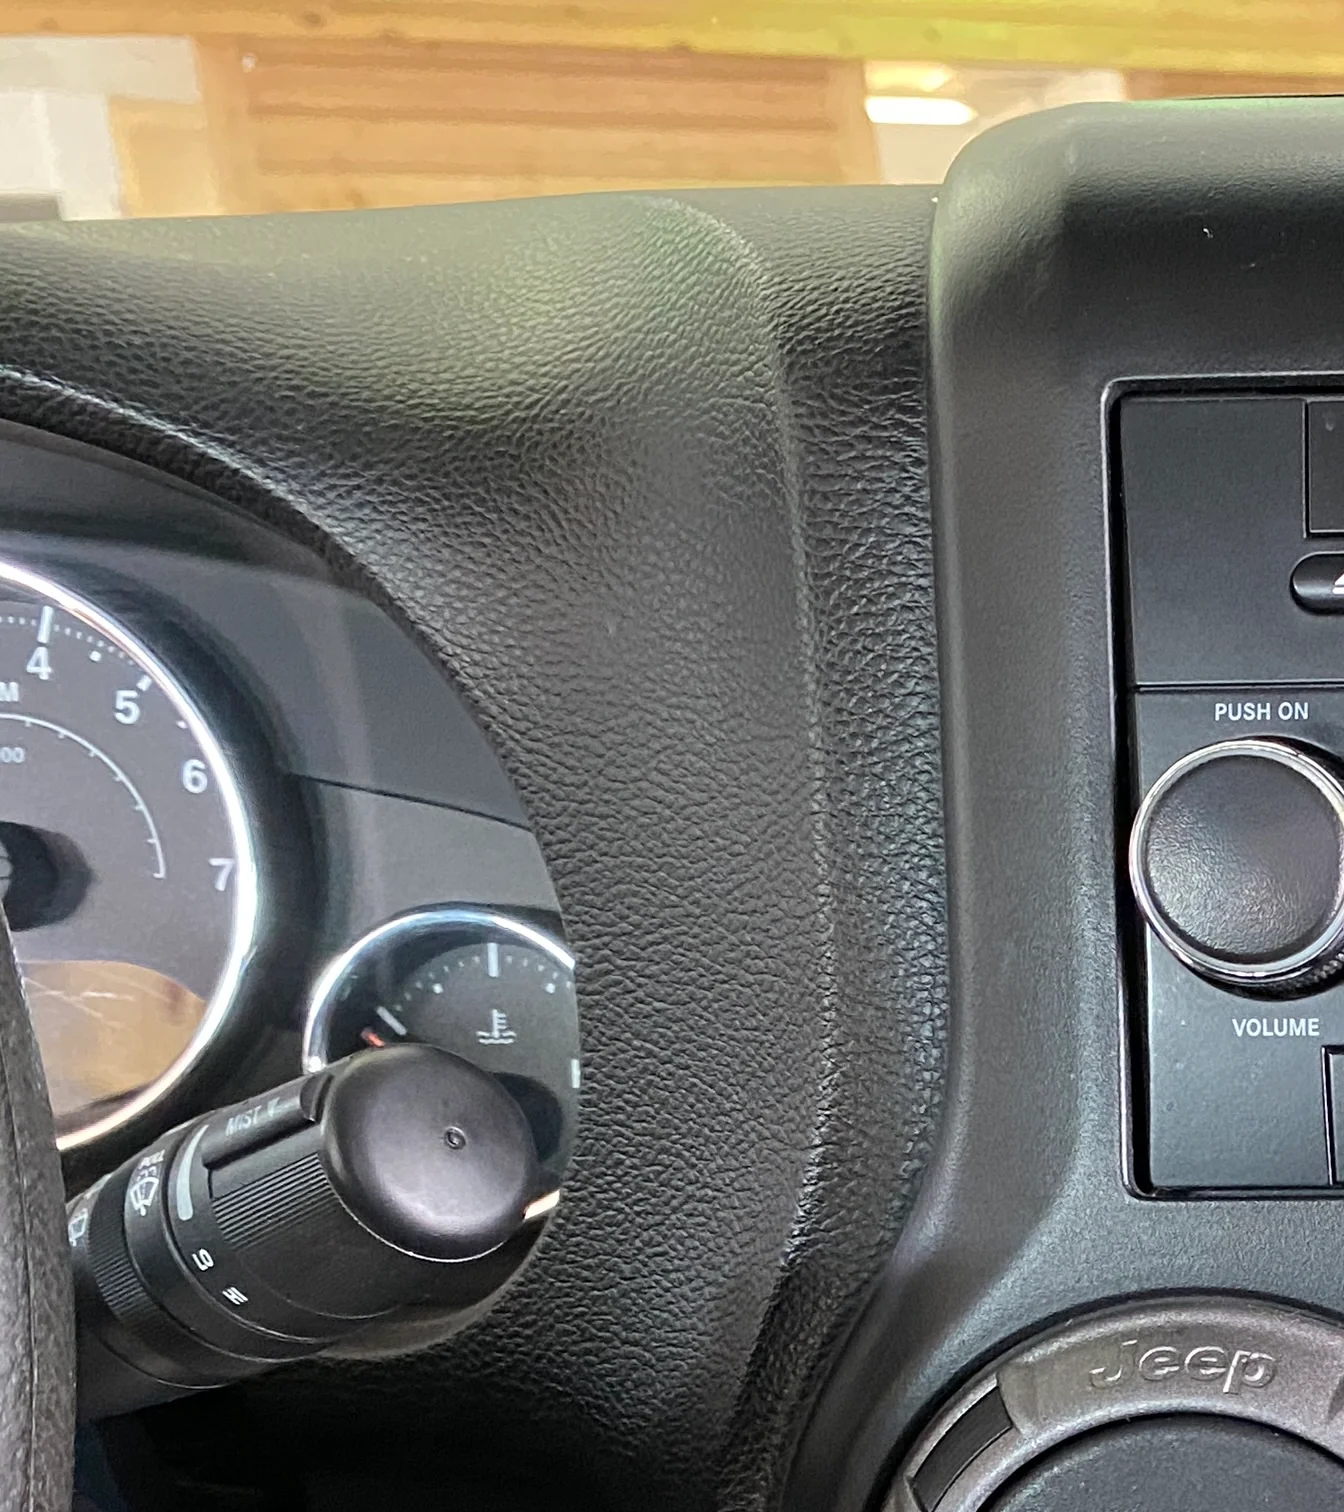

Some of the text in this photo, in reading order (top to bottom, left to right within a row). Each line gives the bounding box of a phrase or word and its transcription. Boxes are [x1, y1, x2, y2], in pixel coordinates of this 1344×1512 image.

[26, 646, 53, 680] 4
[113, 690, 141, 725] 5
[1214, 701, 1309, 721] PUSH ON
[182, 759, 208, 794] 6
[208, 857, 235, 892] 7
[1231, 1017, 1320, 1038] VOLUME
[224, 1104, 262, 1137] MIST
[1089, 1338, 1278, 1396] Jeep
